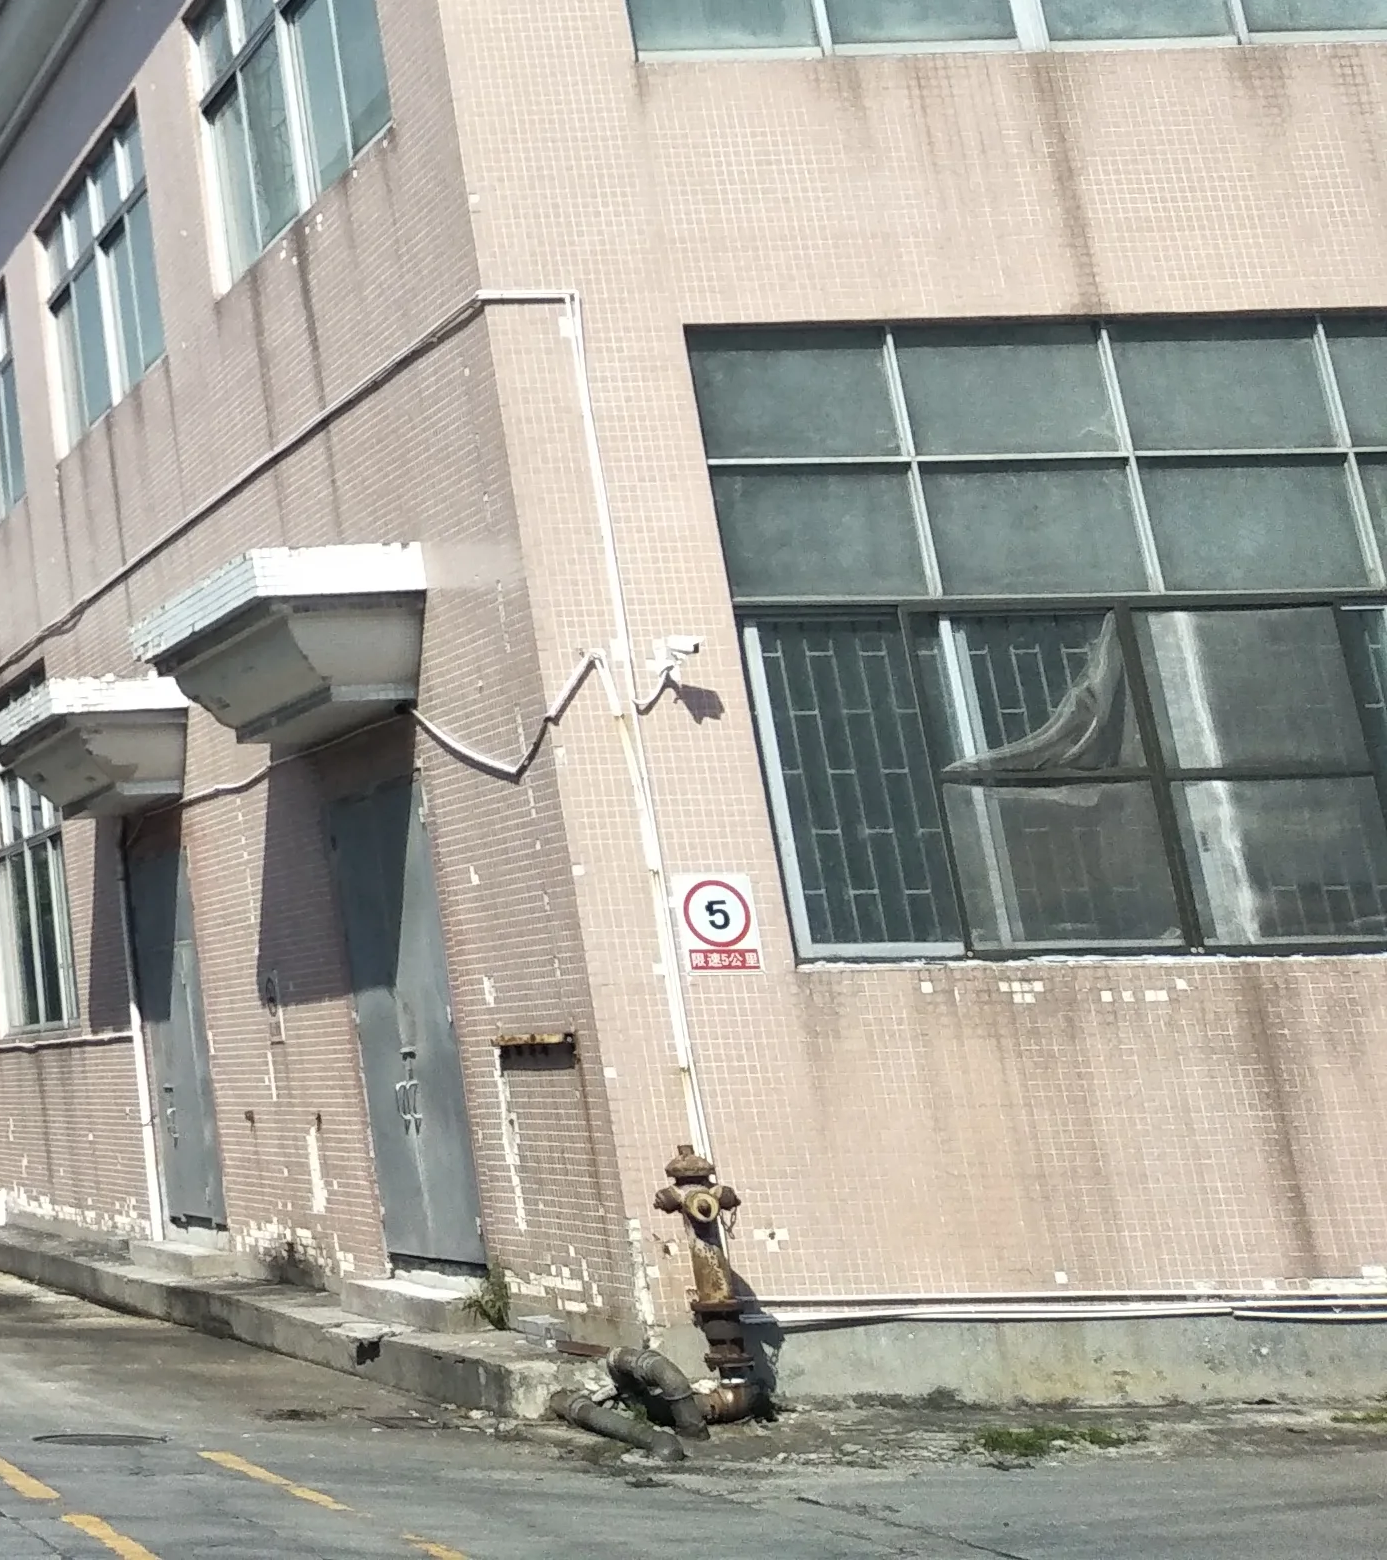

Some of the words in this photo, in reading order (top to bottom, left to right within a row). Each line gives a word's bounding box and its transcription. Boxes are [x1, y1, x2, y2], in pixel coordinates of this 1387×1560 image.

[705, 900, 731, 930] 5
[691, 952, 760, 968] 限速5公里
